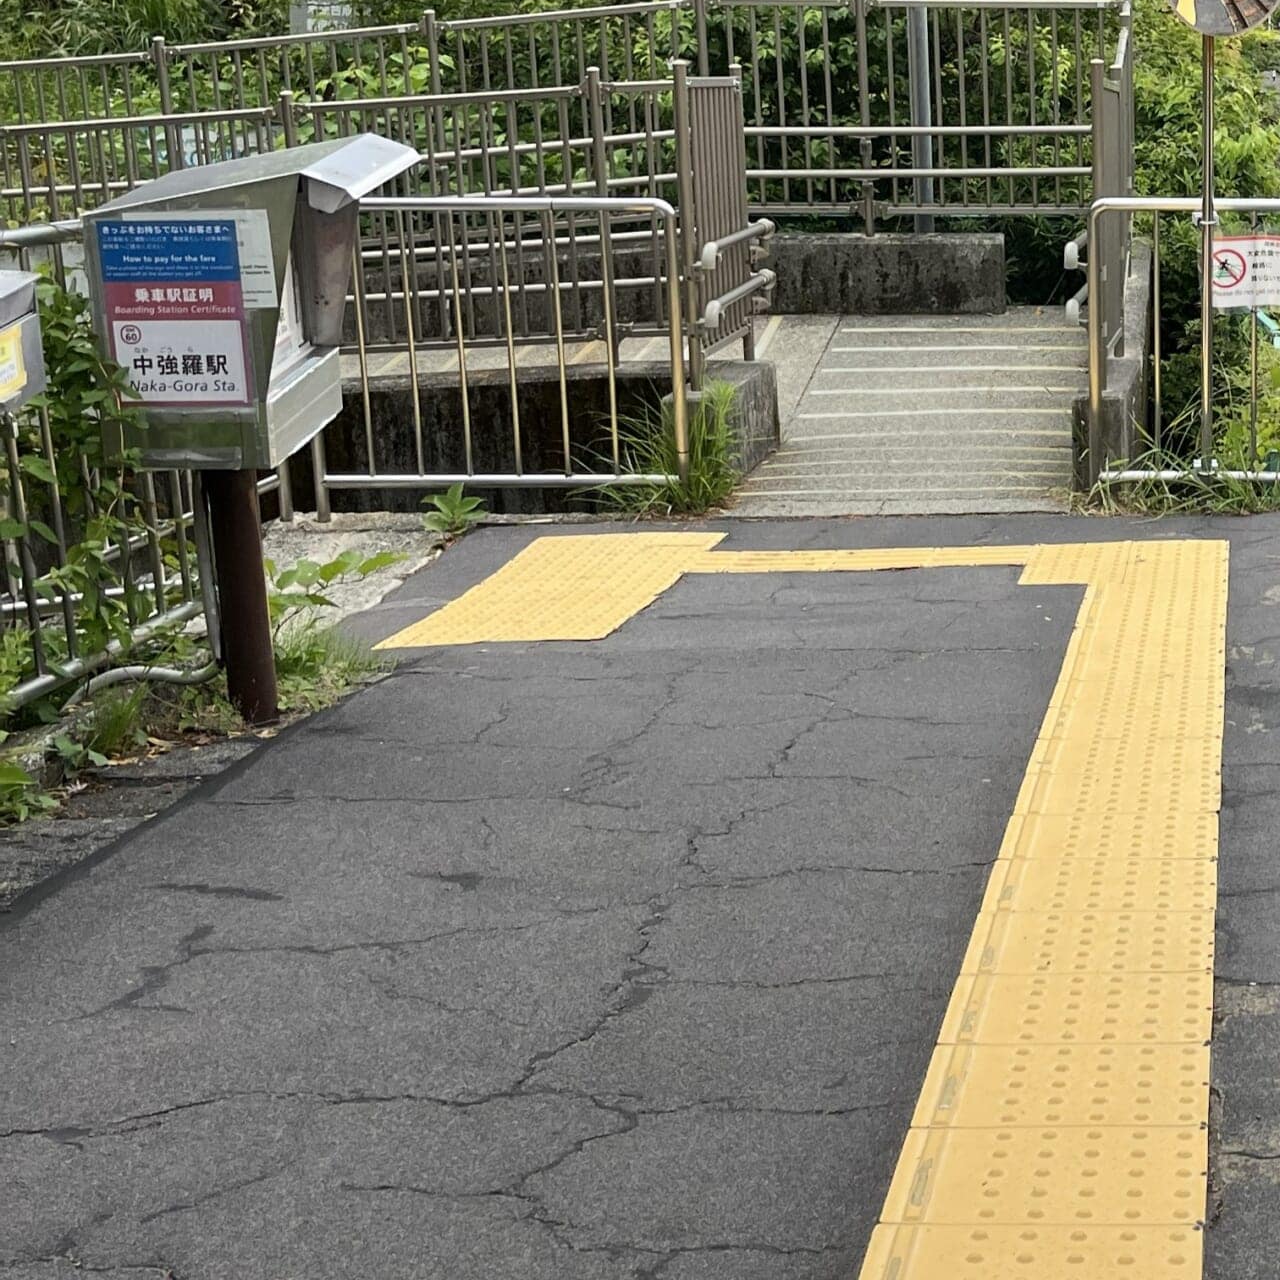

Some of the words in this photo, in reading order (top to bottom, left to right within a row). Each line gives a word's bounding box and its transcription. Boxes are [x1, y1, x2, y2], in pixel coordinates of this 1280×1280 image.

[102, 225, 229, 234] きっぷをお持ちでないお客さまへ
[123, 255, 141, 263] How
[143, 255, 152, 263] to
[154, 256, 169, 265] pay
[171, 254, 182, 262] for
[185, 254, 198, 262] the
[200, 254, 216, 262] fare
[134, 287, 215, 302] 乗車駅証明
[114, 306, 155, 315] Boarding
[157, 305, 188, 314] Station
[191, 305, 236, 314] Certificate
[125, 333, 138, 342] 60
[133, 354, 229, 376] 中強羅駅
[130, 379, 208, 393] Naka-Gora
